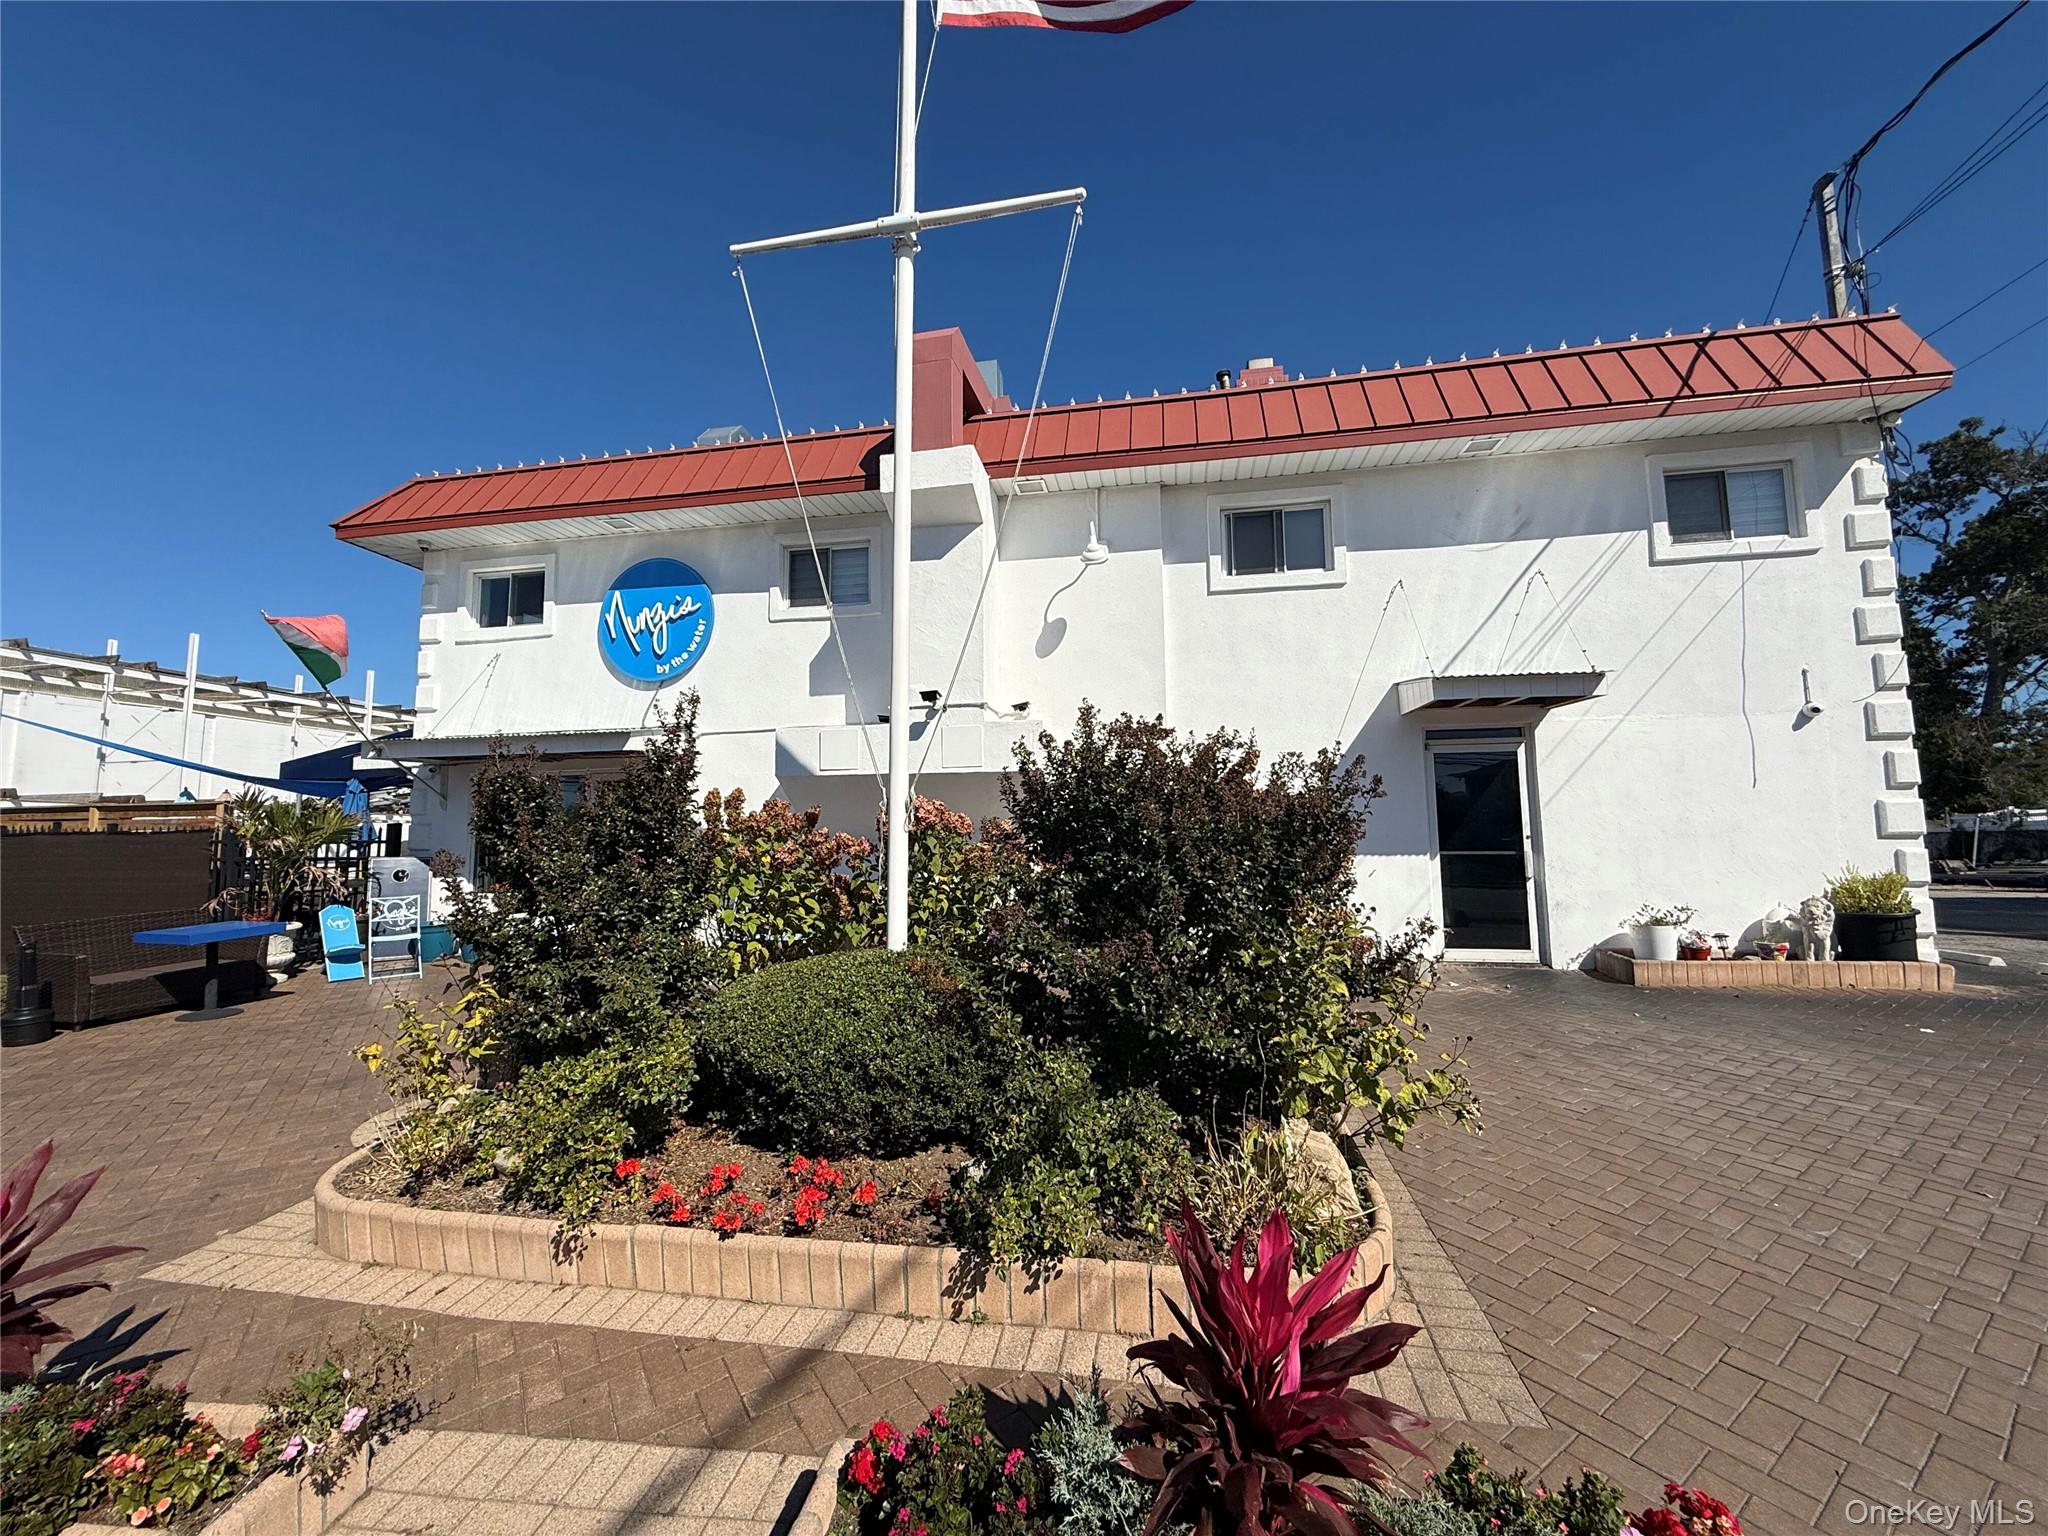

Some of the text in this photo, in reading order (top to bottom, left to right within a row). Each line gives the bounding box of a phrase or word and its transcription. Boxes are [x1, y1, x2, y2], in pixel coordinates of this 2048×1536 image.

[656, 618, 706, 674] by the water
